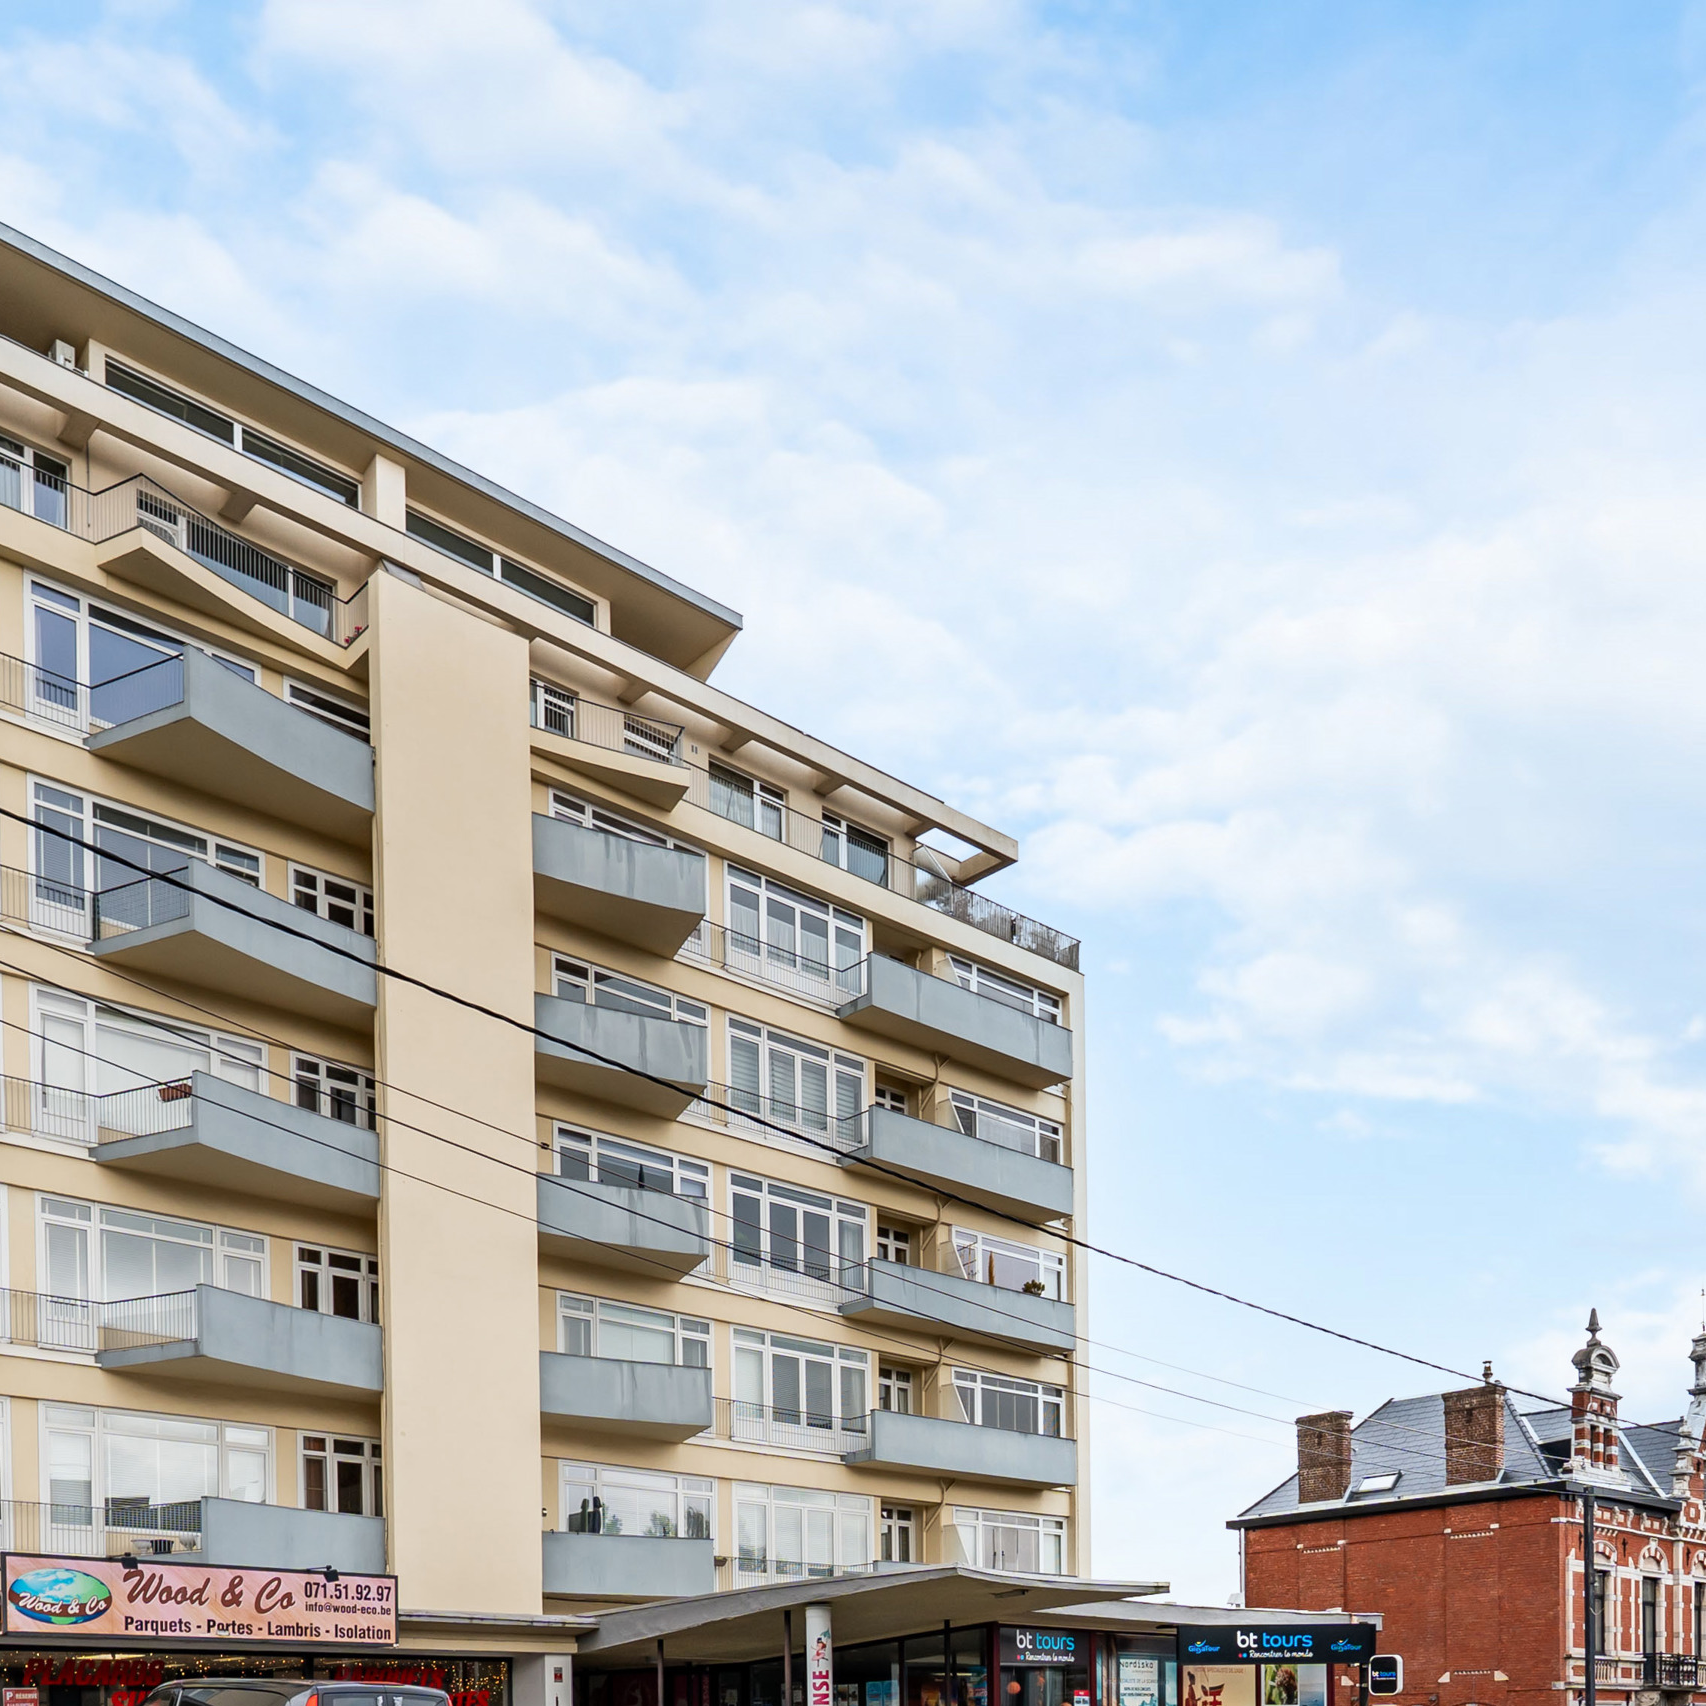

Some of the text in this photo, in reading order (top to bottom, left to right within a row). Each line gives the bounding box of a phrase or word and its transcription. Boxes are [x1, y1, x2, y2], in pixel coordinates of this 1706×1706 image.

[123, 1569, 296, 1614] Wood & Co
[304, 1581, 392, 1603] 071.51.92.97
[18, 1592, 108, 1615] Wood & Co
[305, 1601, 392, 1616] info@wood-eco.be
[124, 1615, 192, 1636] Parquets
[207, 1619, 253, 1636] Portes
[267, 1621, 321, 1638] Lambris
[334, 1624, 392, 1640] Isolation
[1016, 1629, 1075, 1651] bt tours
[1237, 1630, 1313, 1648] bt tours
[22, 1658, 165, 1686] PLACARDS
